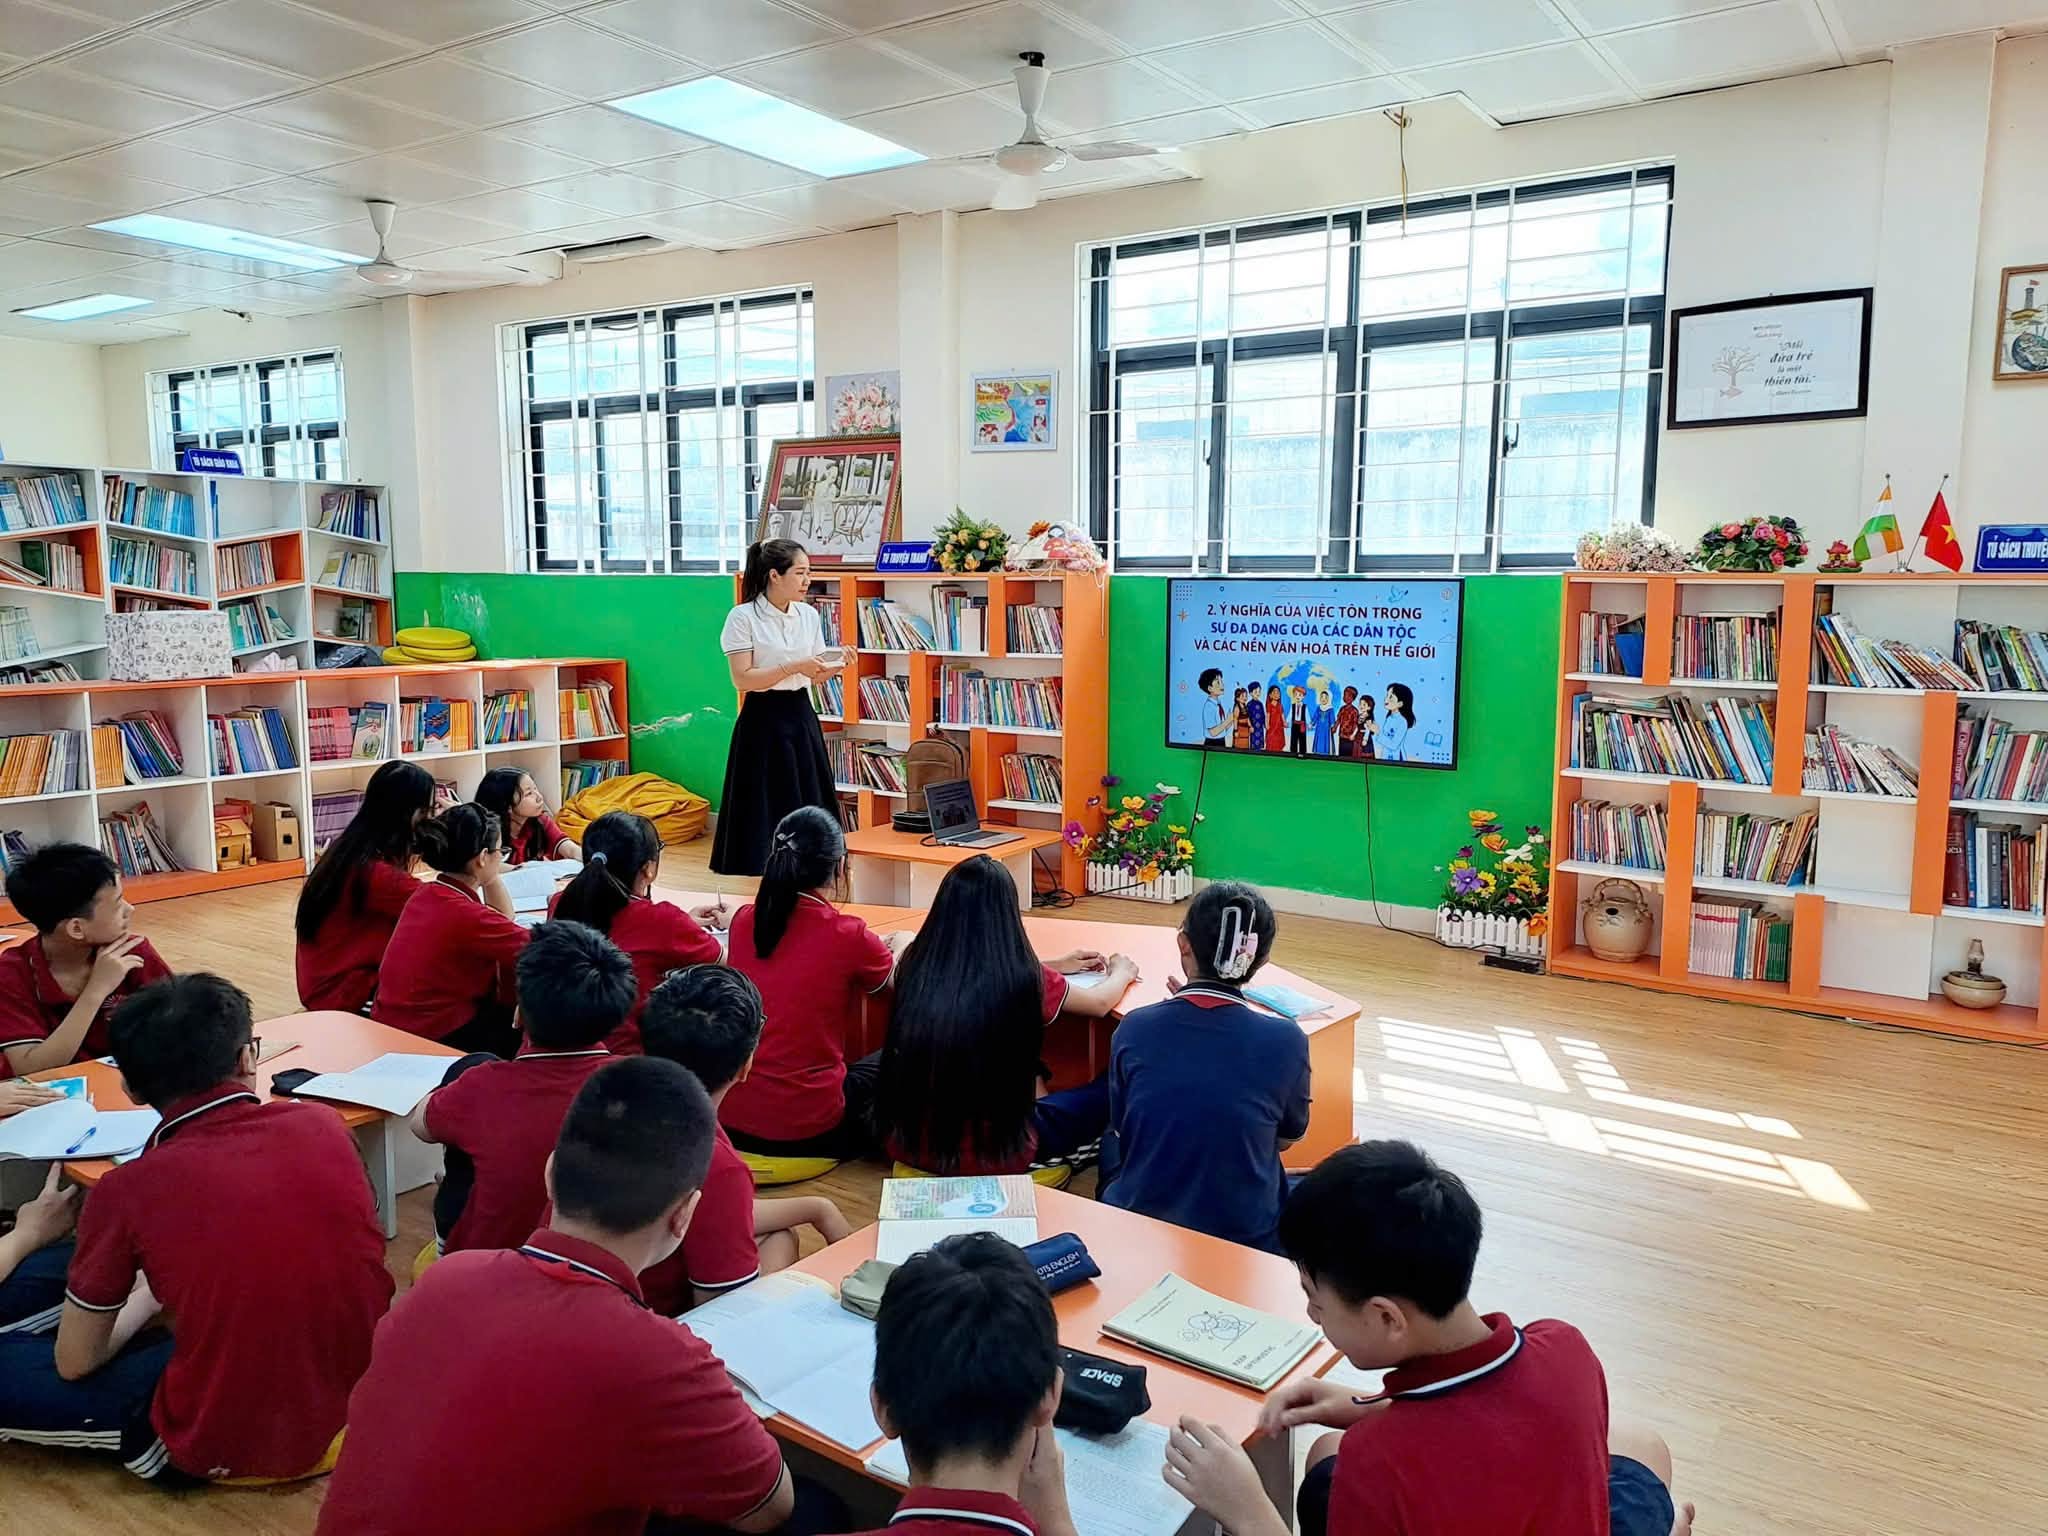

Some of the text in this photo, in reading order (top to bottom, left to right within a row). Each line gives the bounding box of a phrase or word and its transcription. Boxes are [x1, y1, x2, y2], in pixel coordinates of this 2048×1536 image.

[1987, 535, 2048, 562] TỦ SÁCH TRUYỆ
[1207, 601, 1422, 622] 2. Ý NGHĨA CỦA VIỆC TÔN TRỌNG
[1211, 621, 1417, 642] SỰ ĐA DẠNG CỦA CÁC DÂN TỘC
[1194, 636, 1210, 651] VÀ
[1213, 637, 1237, 652] CÁC
[1271, 639, 1297, 654] VĂN
[1301, 640, 1330, 655] HOÁ
[1334, 641, 1369, 657] TRÊN
[1373, 639, 1403, 657] THẾ
[1405, 642, 1436, 659] GIỚI
[1036, 1264, 1052, 1276] OTS
[1050, 1251, 1081, 1270] ENGLISH
[1080, 1367, 1124, 1388] SPACE
